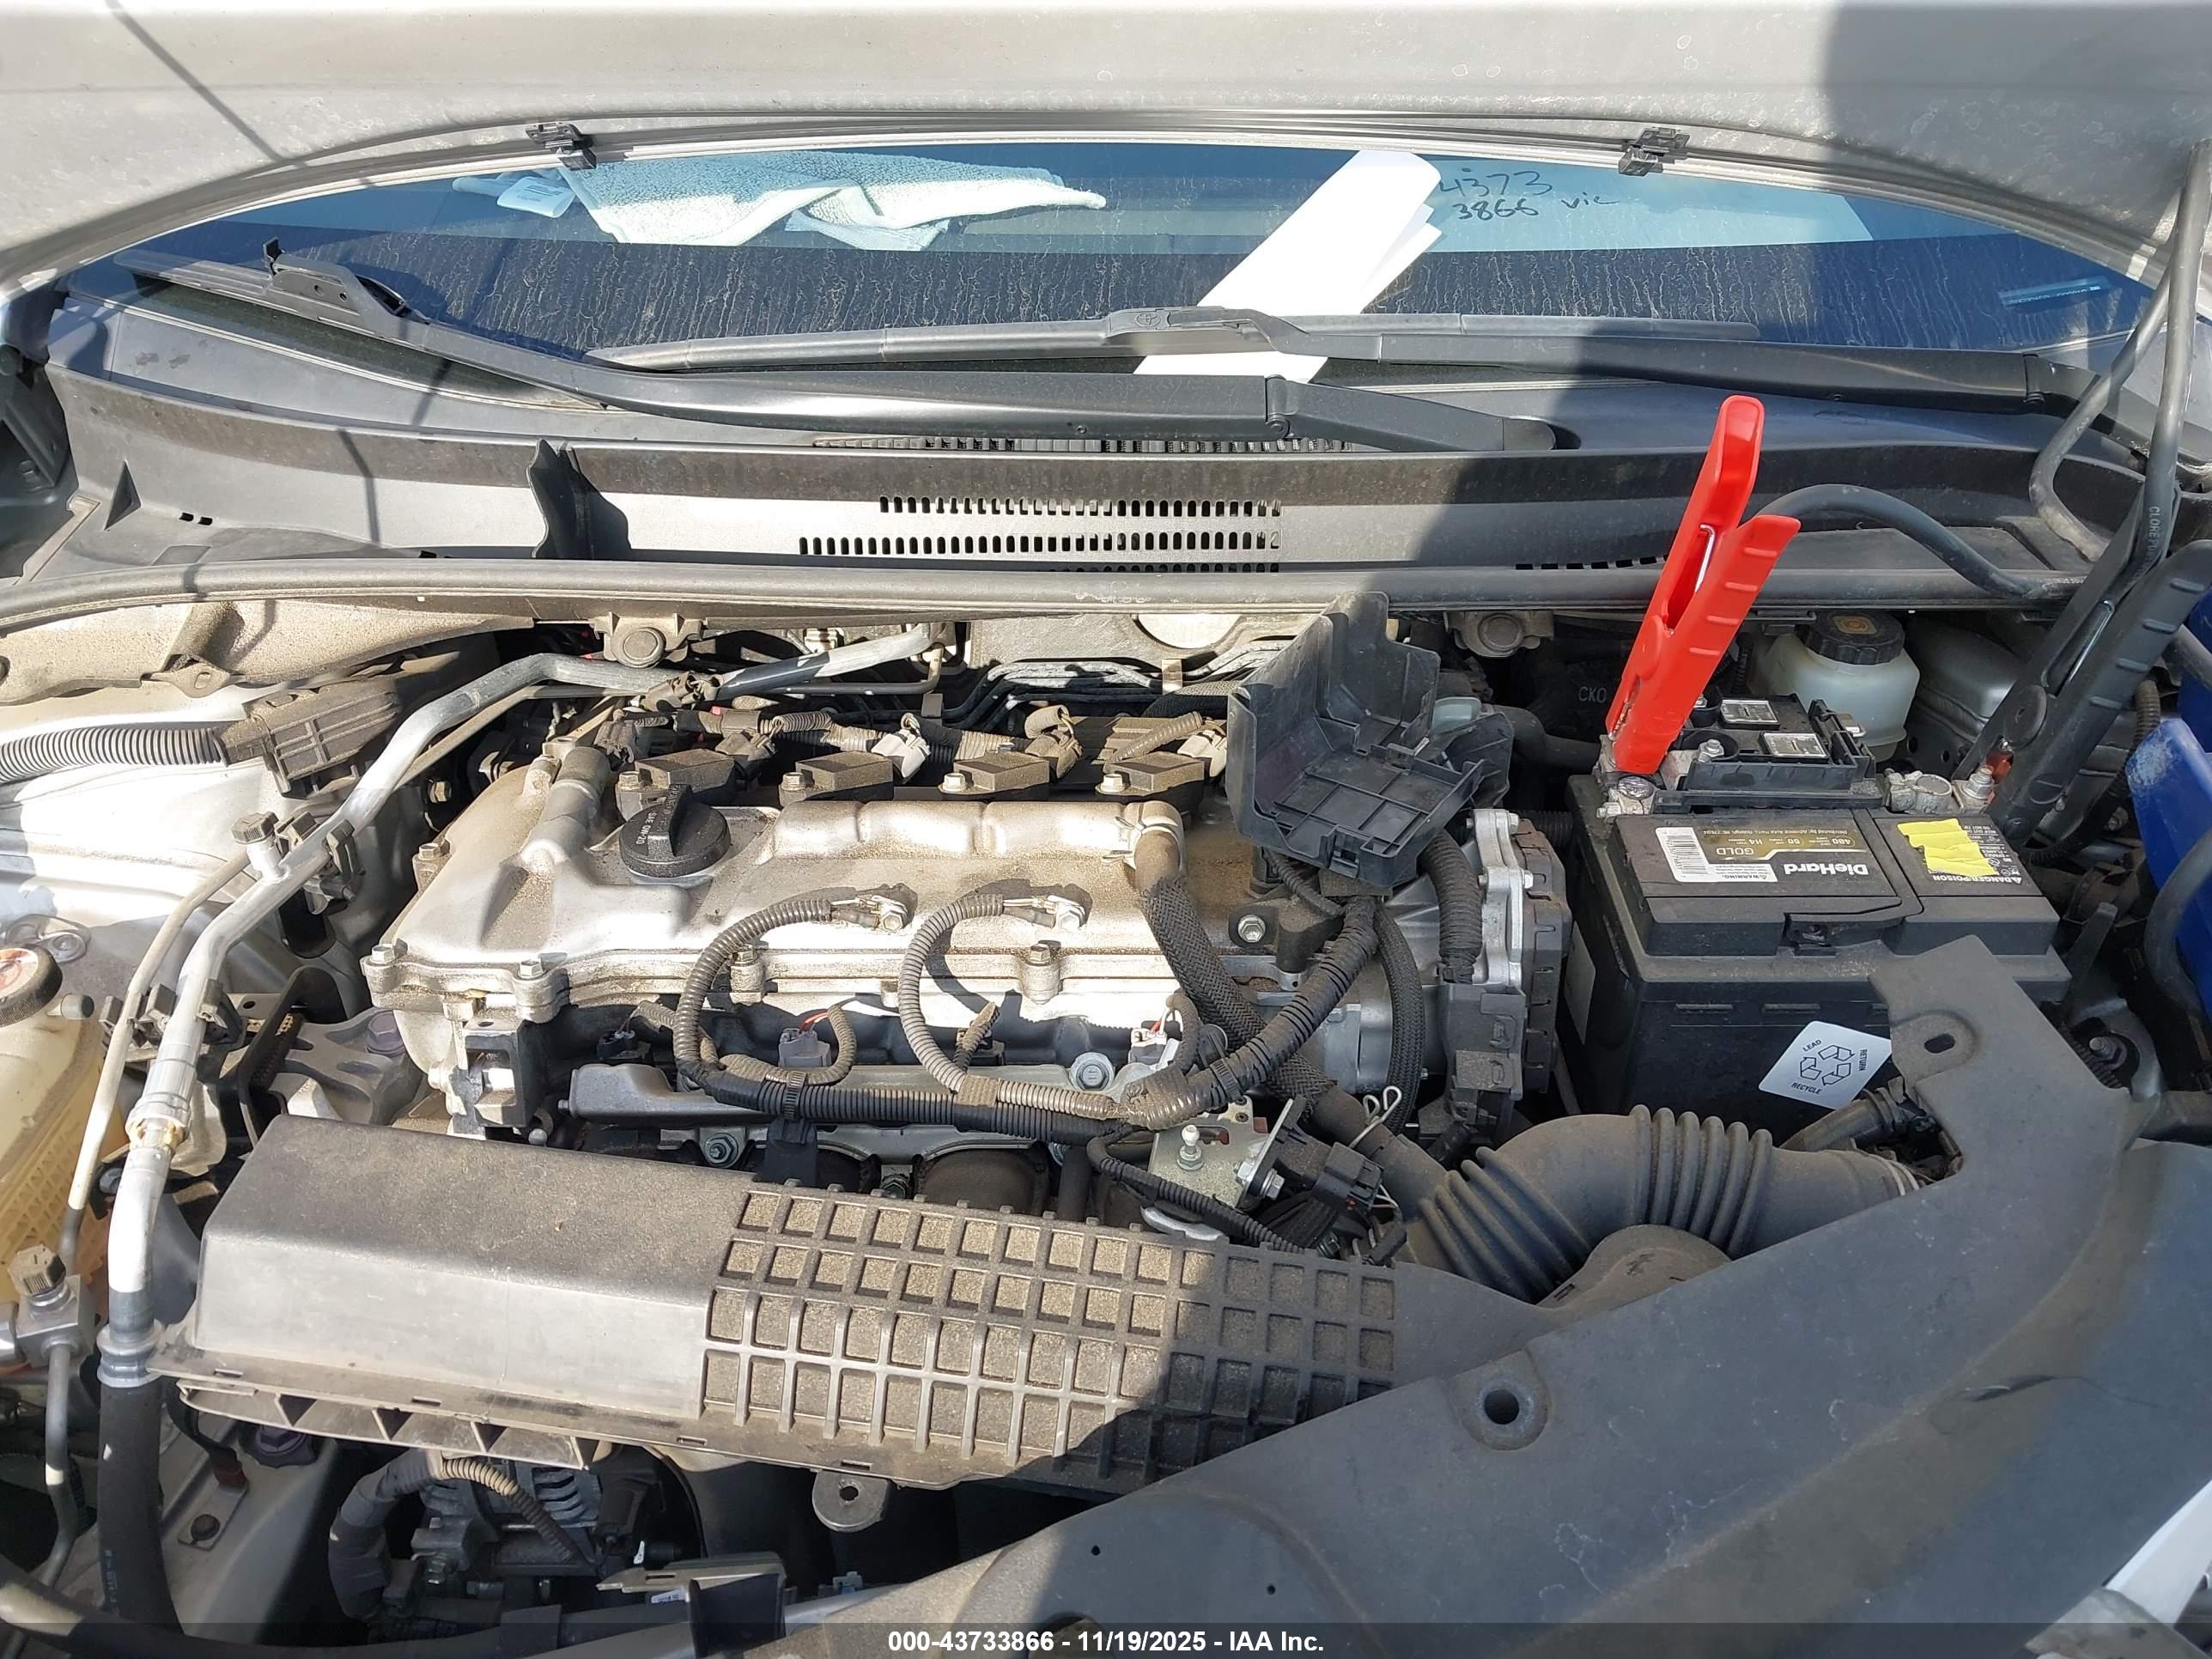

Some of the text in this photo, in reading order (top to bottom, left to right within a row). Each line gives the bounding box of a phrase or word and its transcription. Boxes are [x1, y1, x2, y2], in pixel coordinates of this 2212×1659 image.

[1439, 171, 1553, 198] 4373
[1452, 198, 1540, 221] 3866
[2148, 506, 2161, 538] CLORE
[636, 811, 657, 845] SAE 0W-20
[1783, 863, 1869, 875] DieHard
[1802, 1039, 1822, 1052] LEAD
[1858, 1048, 1868, 1072] RETURN
[1790, 1082, 1822, 1095] RECYCLE
